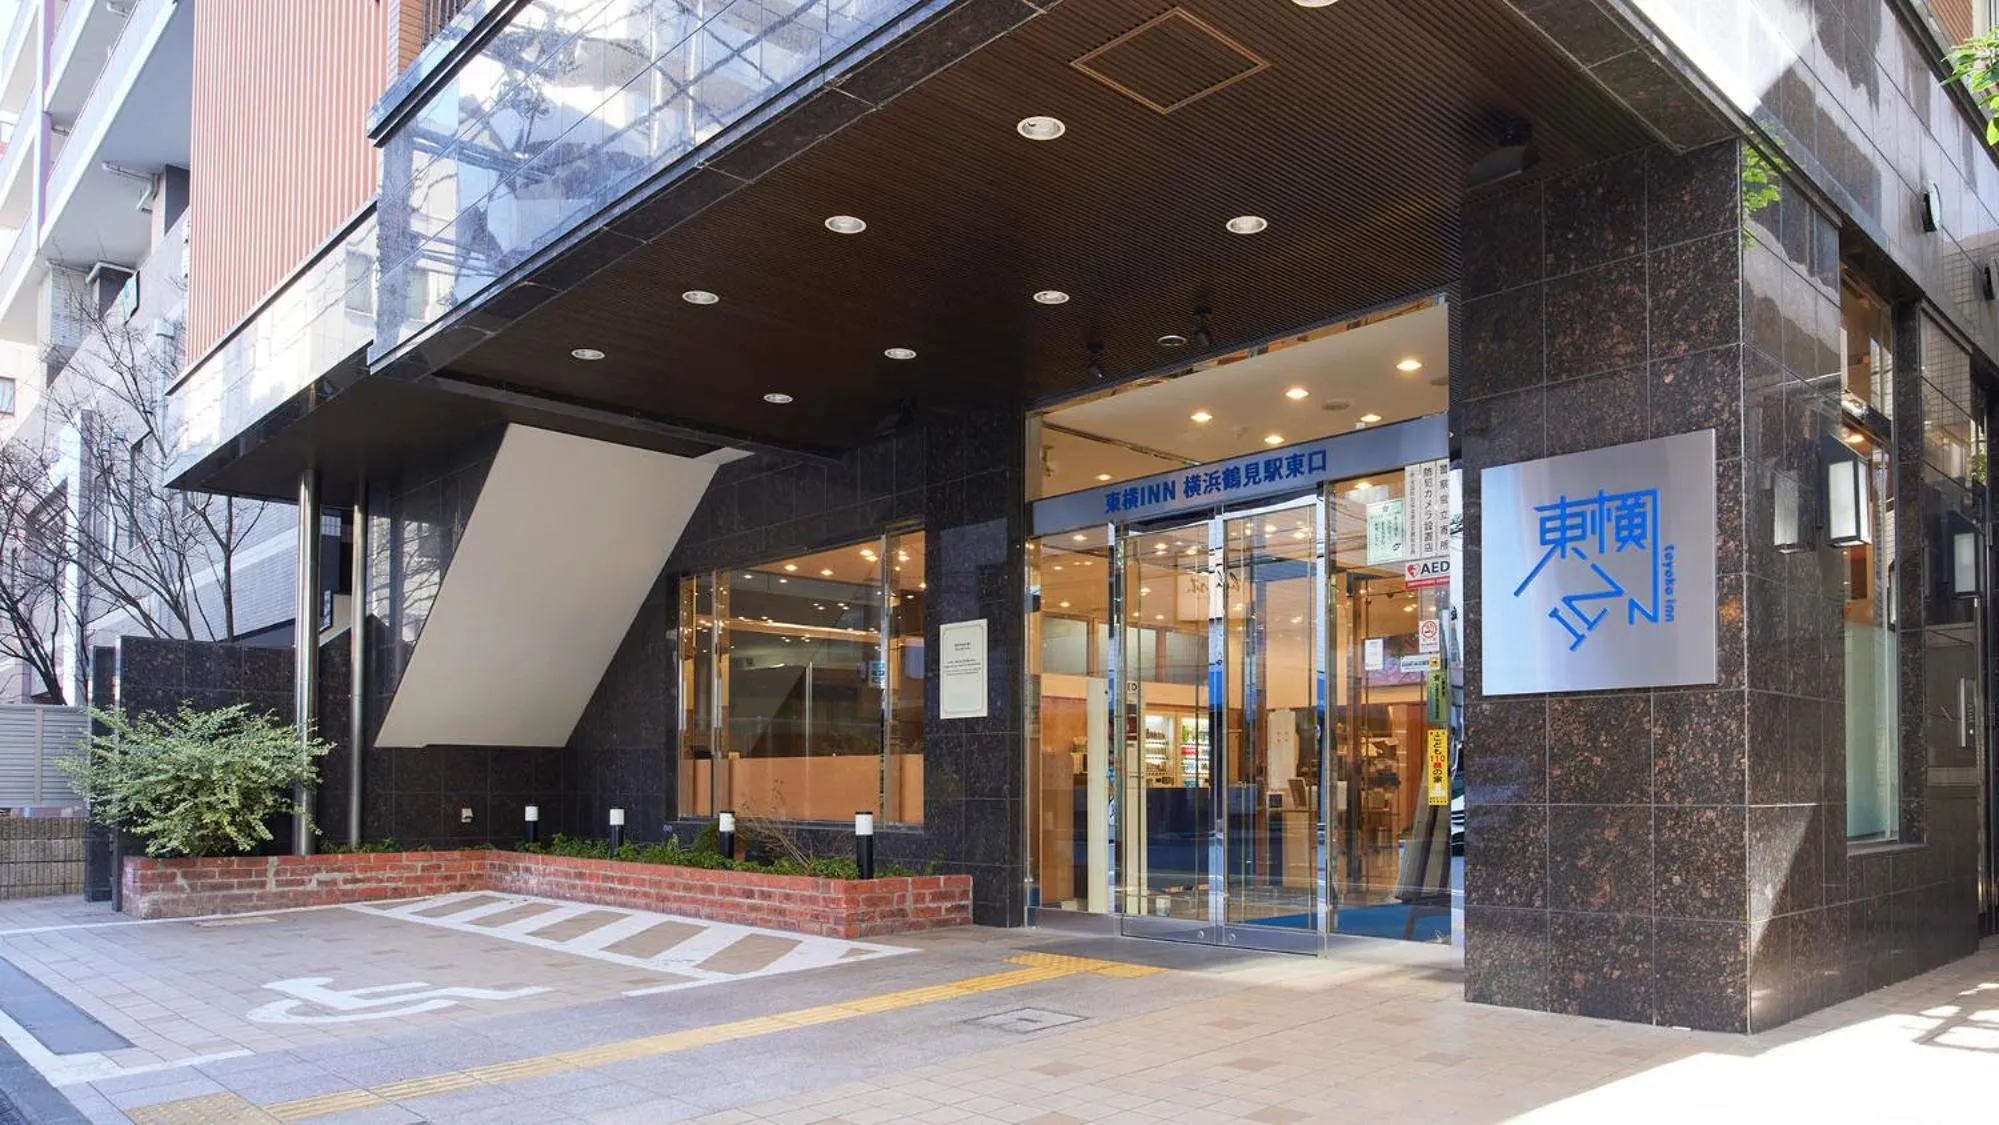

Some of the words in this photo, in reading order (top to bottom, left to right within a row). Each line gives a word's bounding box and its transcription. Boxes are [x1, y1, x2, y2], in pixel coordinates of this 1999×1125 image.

[1104, 479, 1177, 514] 東横INN
[1183, 448, 1328, 499] 横浜鶴見駅東口
[1423, 466, 1434, 553] 防犯カメラ設置店
[1420, 560, 1451, 575] AED
[1664, 599, 1677, 623] inn
